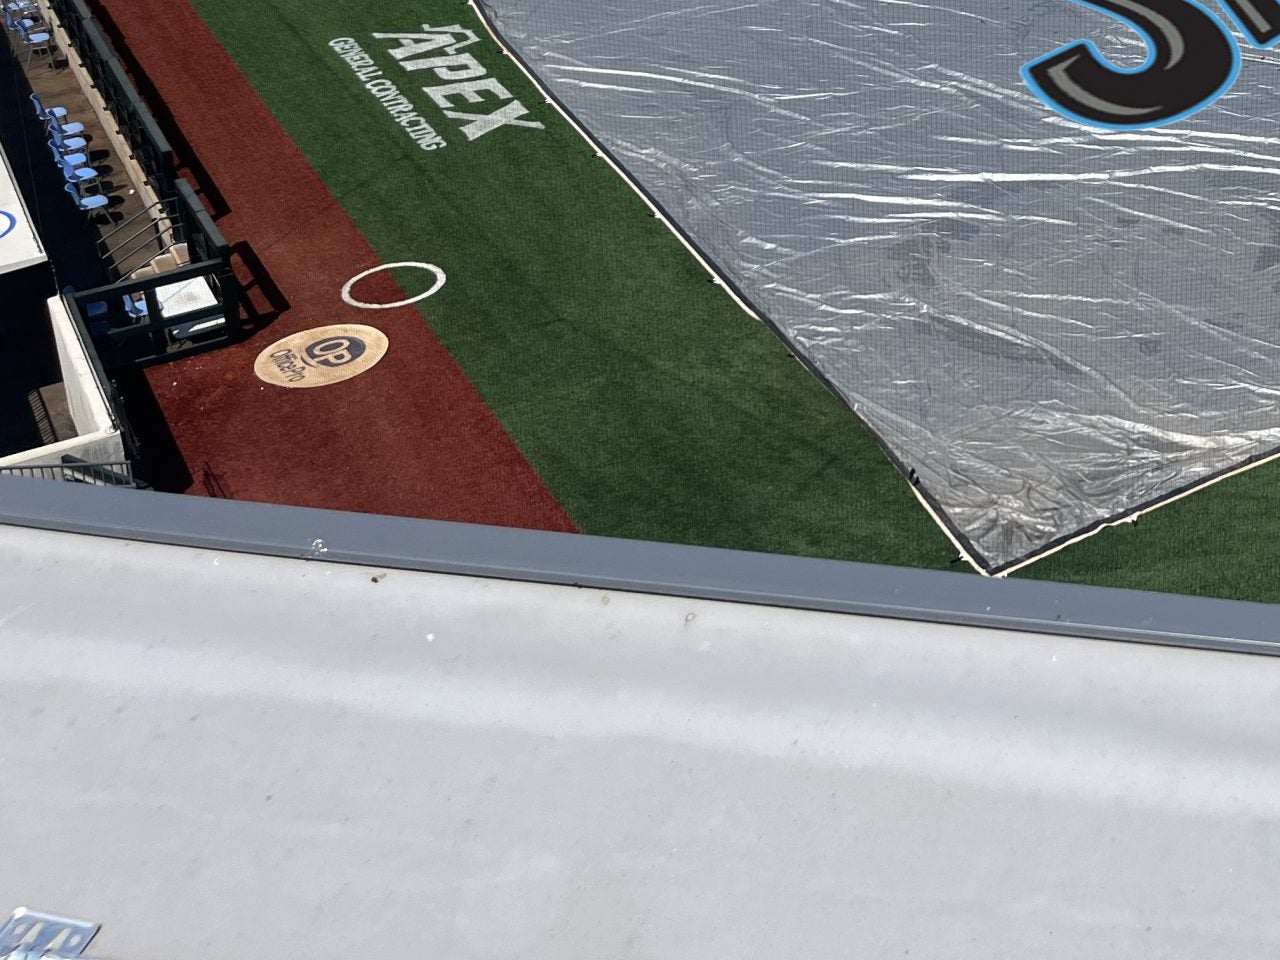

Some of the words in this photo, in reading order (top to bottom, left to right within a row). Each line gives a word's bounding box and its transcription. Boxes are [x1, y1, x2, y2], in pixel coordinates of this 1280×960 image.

[328, 37, 383, 81] GENERAL
[365, 78, 447, 151] CONTRACTING
[372, 24, 545, 140] APEX
[270, 348, 306, 382] OfficePro
